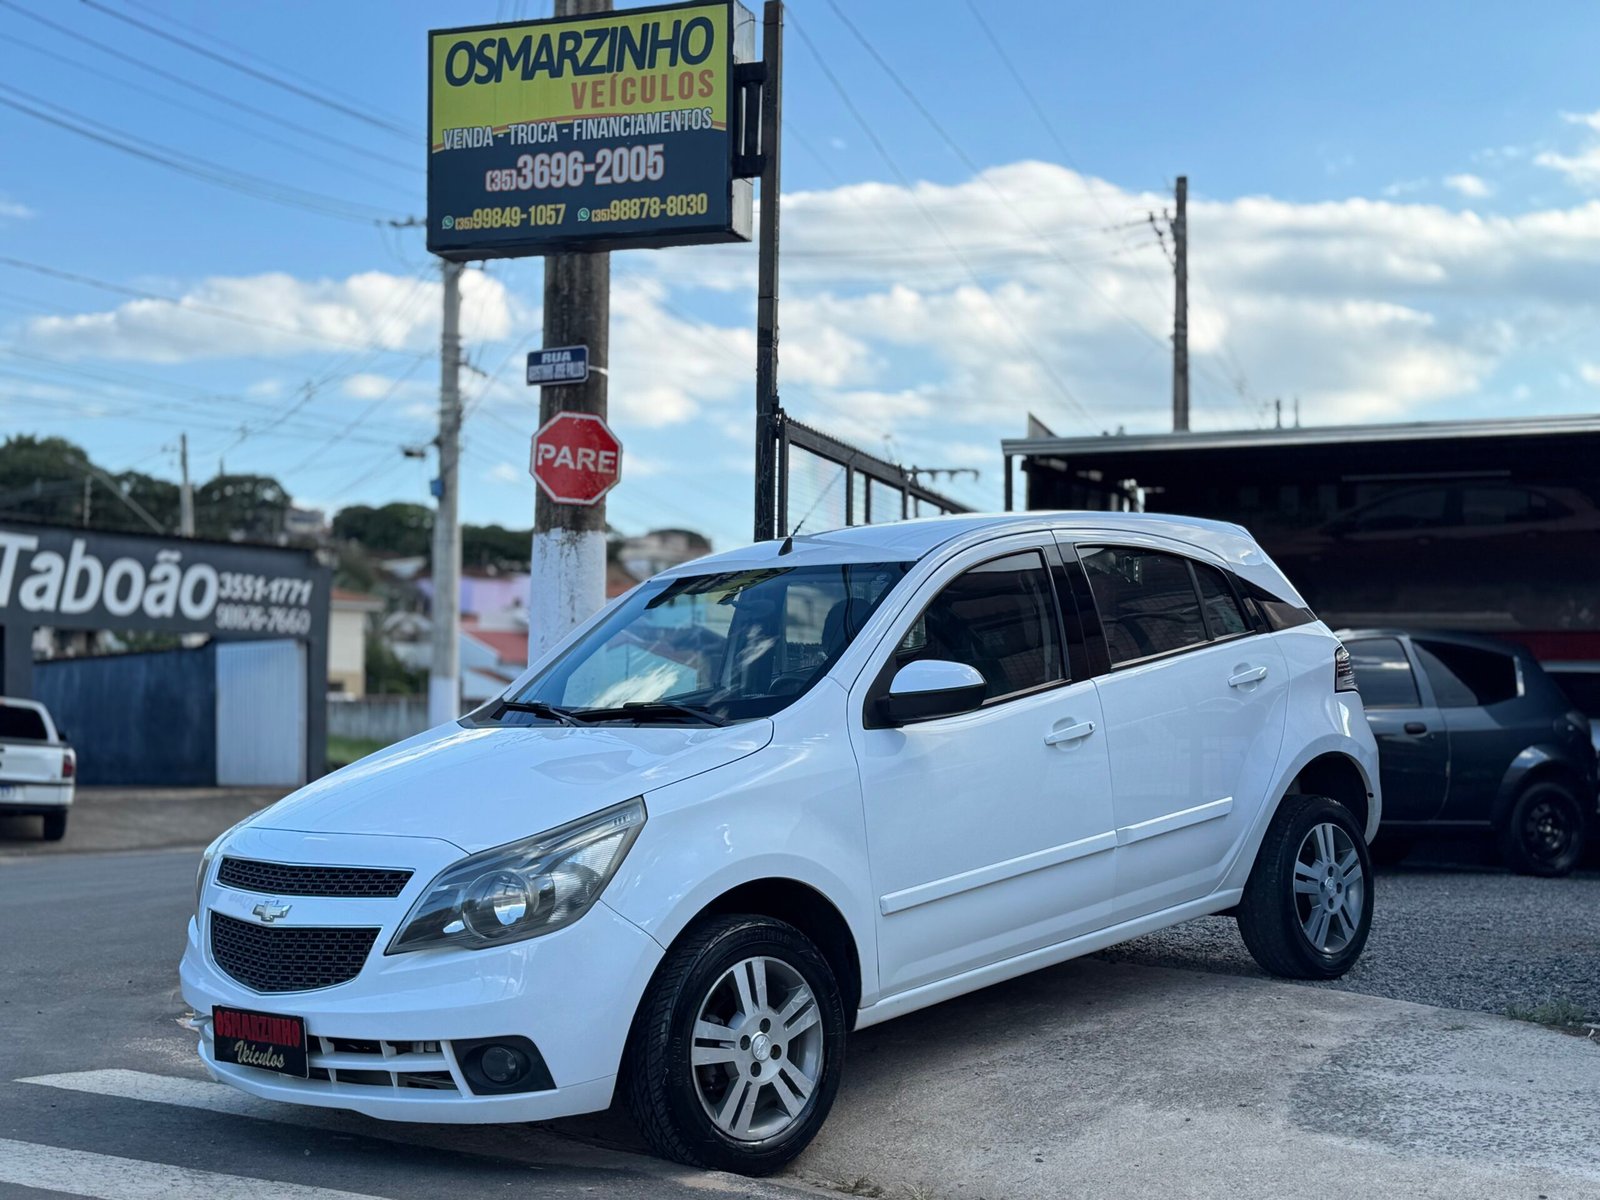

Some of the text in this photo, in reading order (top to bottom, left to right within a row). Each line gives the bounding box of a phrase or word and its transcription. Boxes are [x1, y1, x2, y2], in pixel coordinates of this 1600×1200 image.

[444, 16, 714, 87] OSMARZINHO
[571, 69, 714, 110] VEÍCULOS
[443, 126, 494, 150] VENDA
[508, 119, 558, 145] TROCA
[573, 107, 713, 141] FINANCIAMENTOS
[541, 351, 572, 364] RUA
[536, 443, 617, 474] PARE
[0, 530, 219, 620] Taboão
